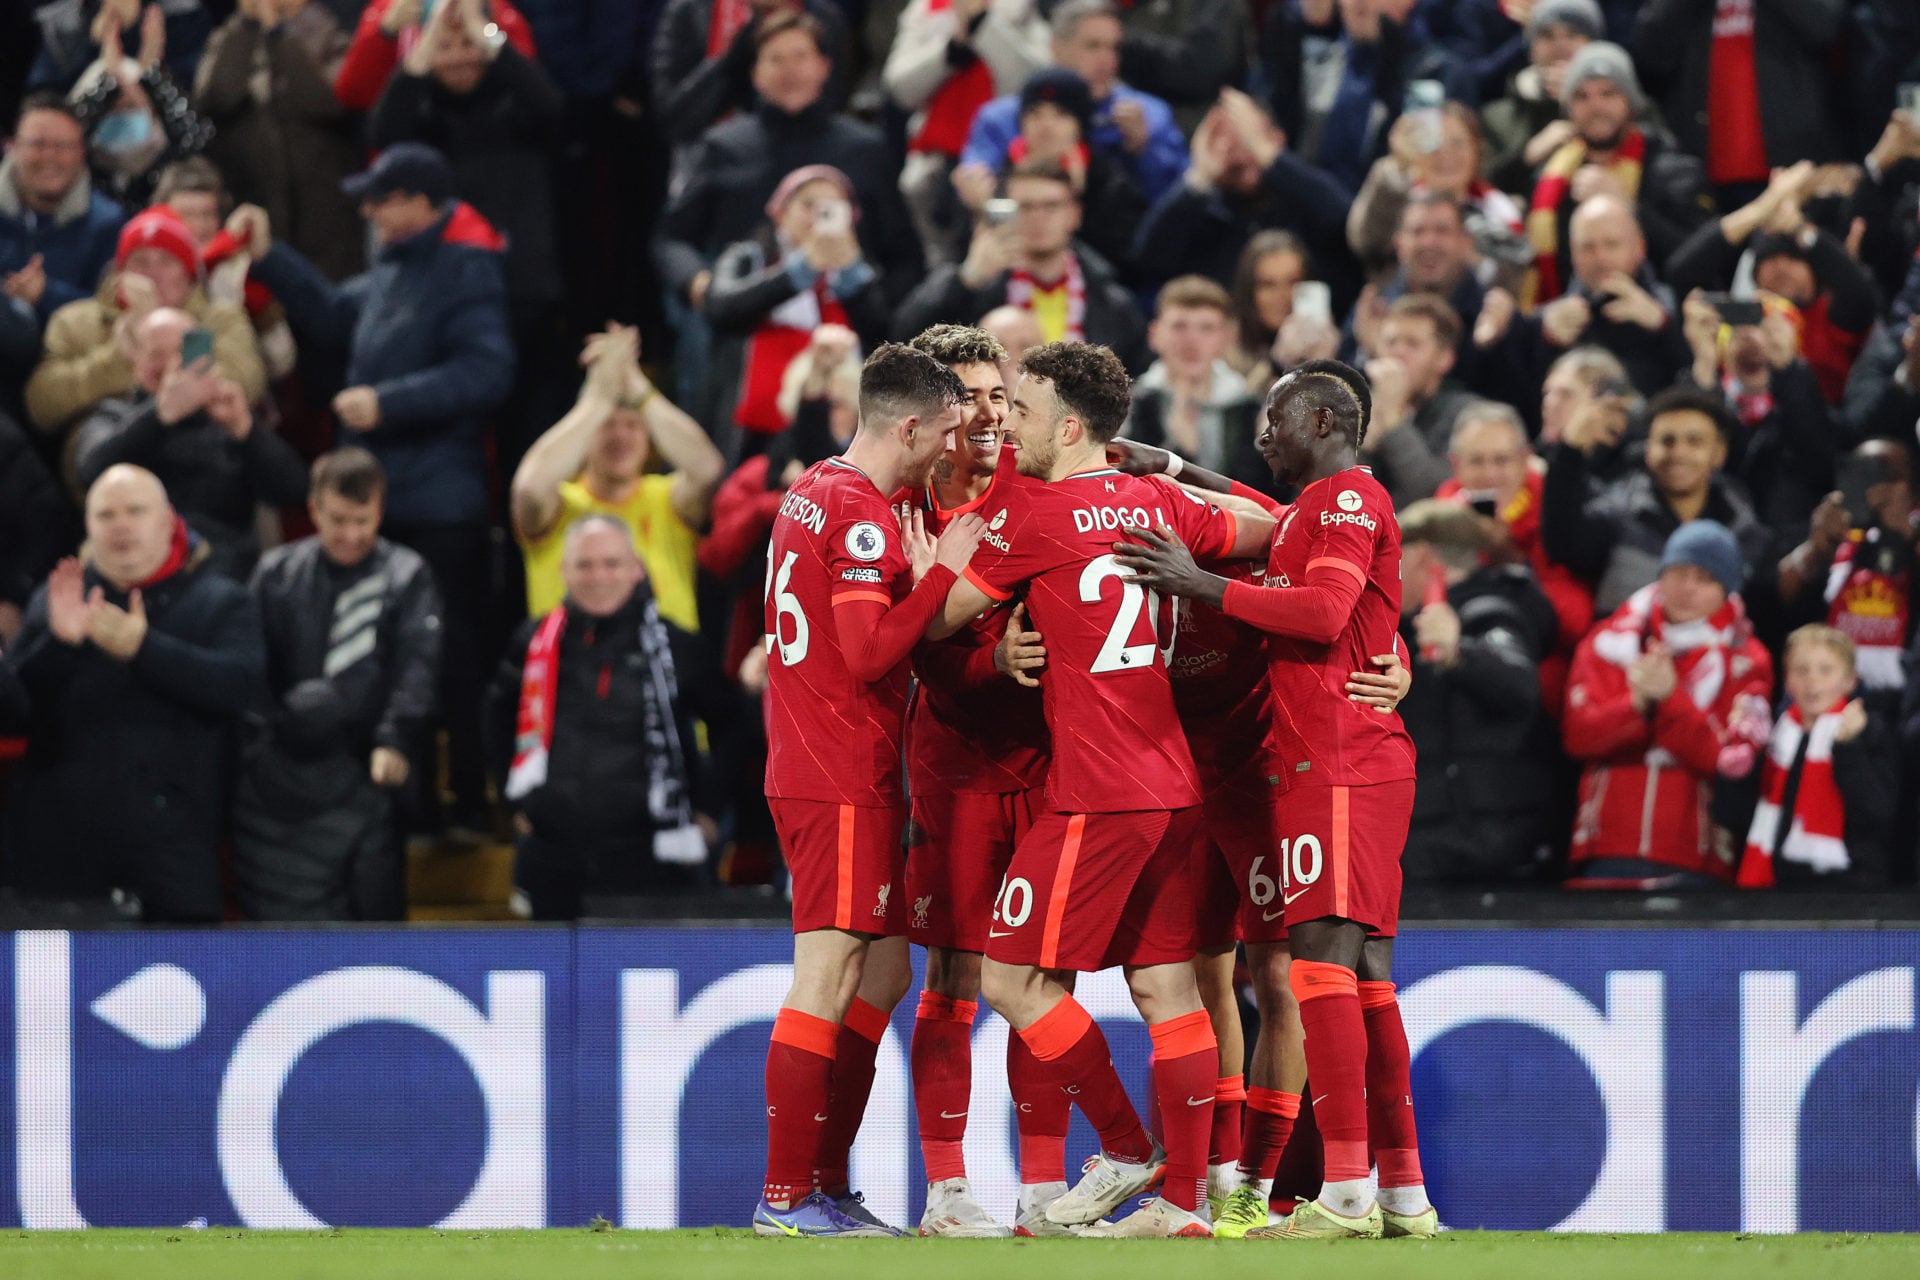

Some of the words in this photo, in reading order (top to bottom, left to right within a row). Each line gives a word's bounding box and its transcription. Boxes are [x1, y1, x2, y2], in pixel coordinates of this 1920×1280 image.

[1072, 506, 1149, 533] DIOGO
[1320, 510, 1376, 531] Expedia
[983, 529, 1010, 552] edia
[1280, 833, 1323, 888] 10
[872, 907, 887, 917] LFC
[911, 920, 929, 929] LFC
